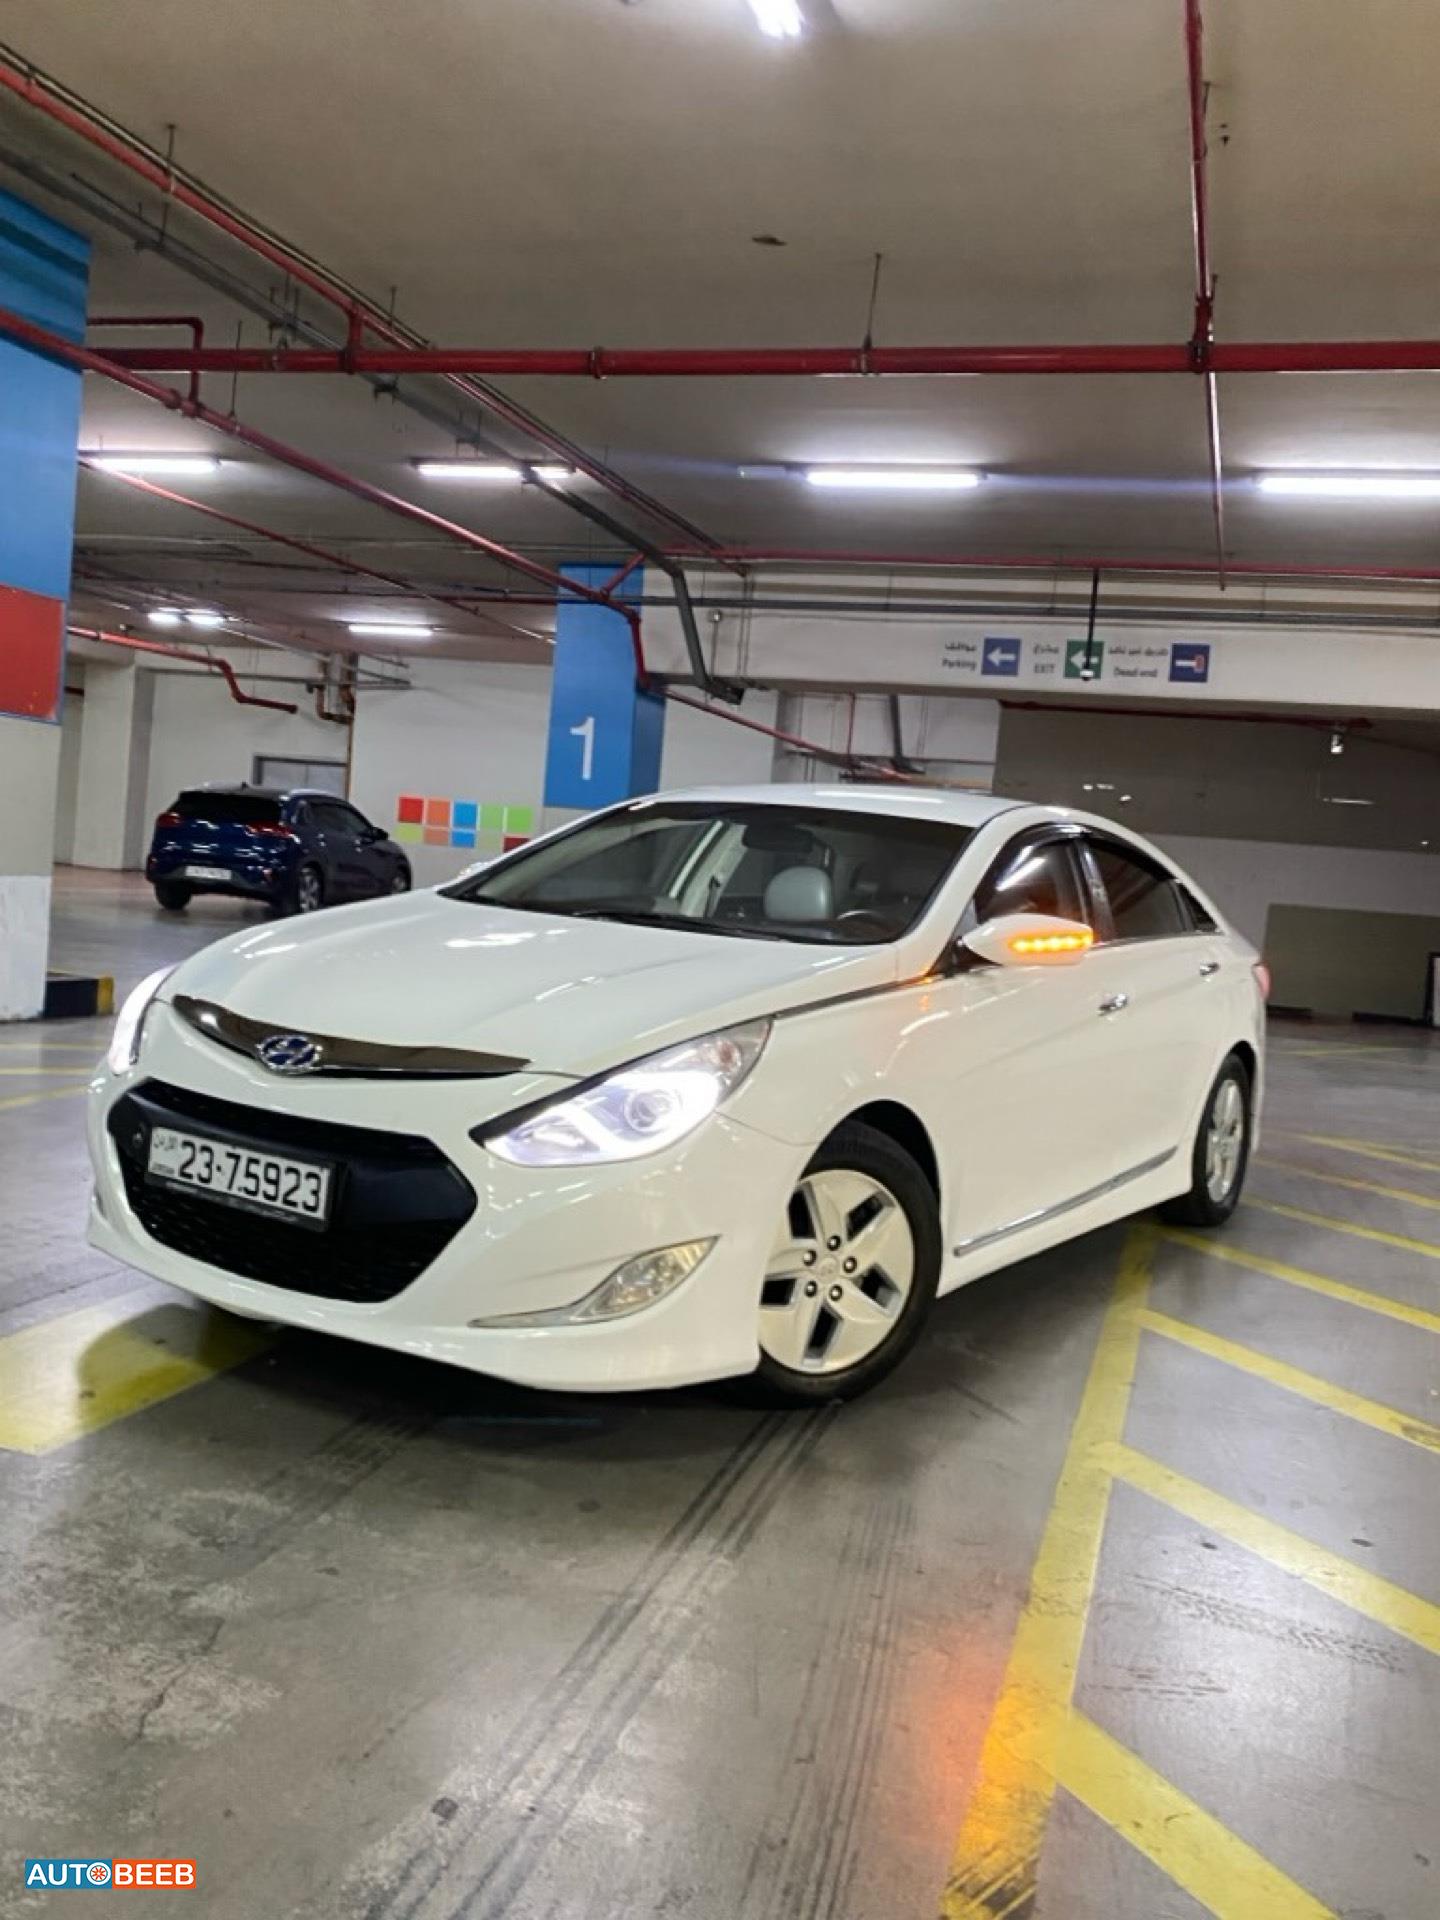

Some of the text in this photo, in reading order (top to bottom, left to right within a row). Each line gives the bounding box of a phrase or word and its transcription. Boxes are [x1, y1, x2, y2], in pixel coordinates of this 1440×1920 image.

[942, 659, 977, 672] Parking
[1034, 663, 1056, 674] EXIT
[1113, 667, 1158, 678] Dead end
[569, 716, 595, 780] 1
